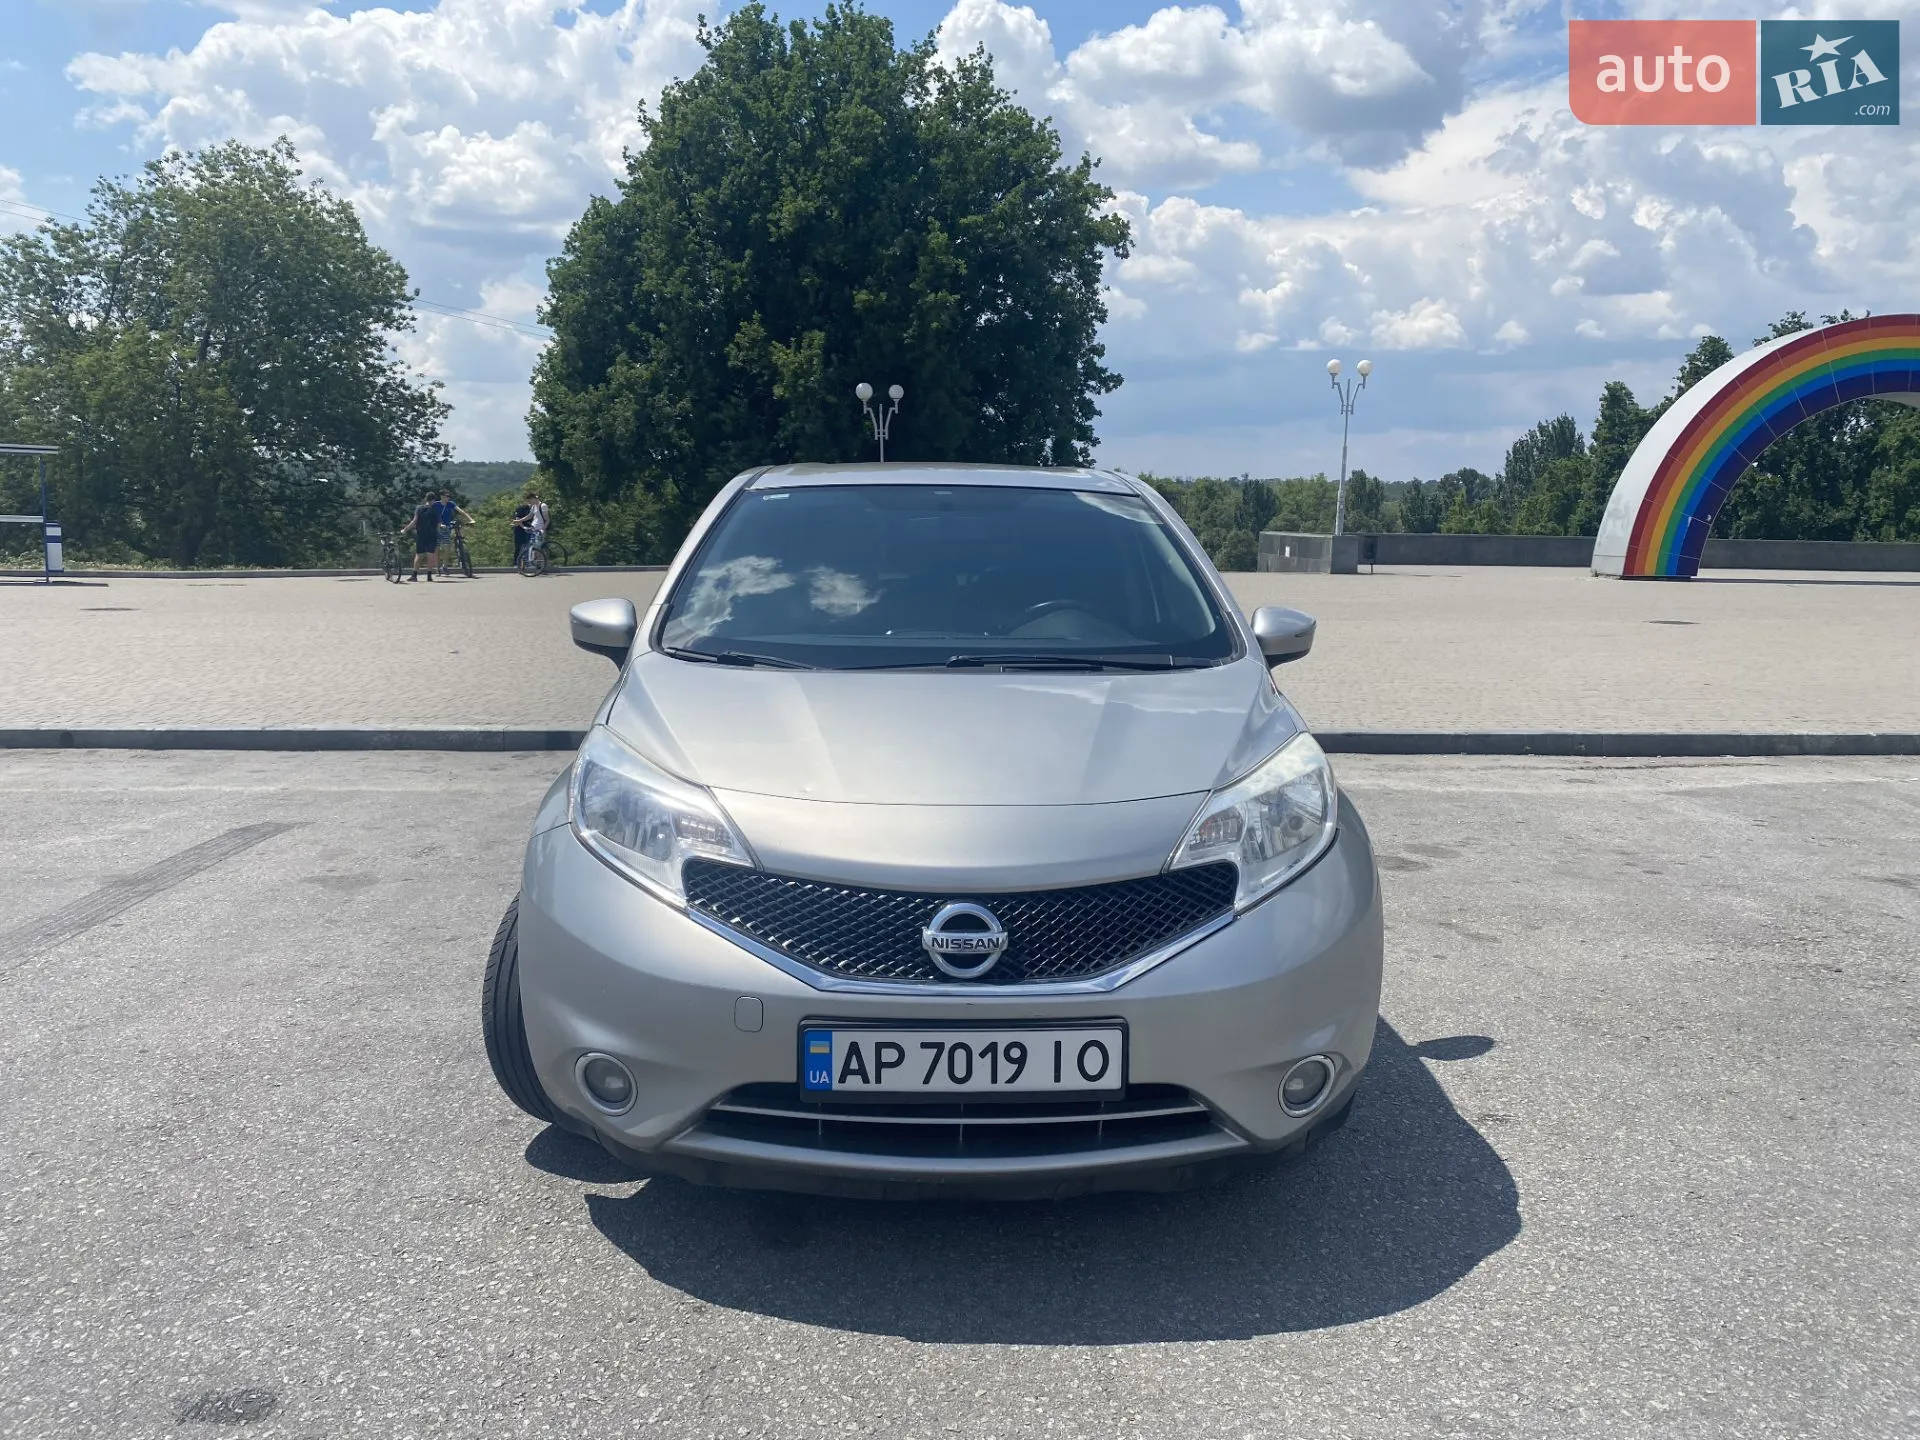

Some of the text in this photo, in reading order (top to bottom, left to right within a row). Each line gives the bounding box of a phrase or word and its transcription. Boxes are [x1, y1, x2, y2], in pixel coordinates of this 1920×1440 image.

[931, 936, 1001, 950] NISSAN
[837, 1039, 1110, 1085] AP 7019 IO
[809, 1070, 830, 1084] UA
